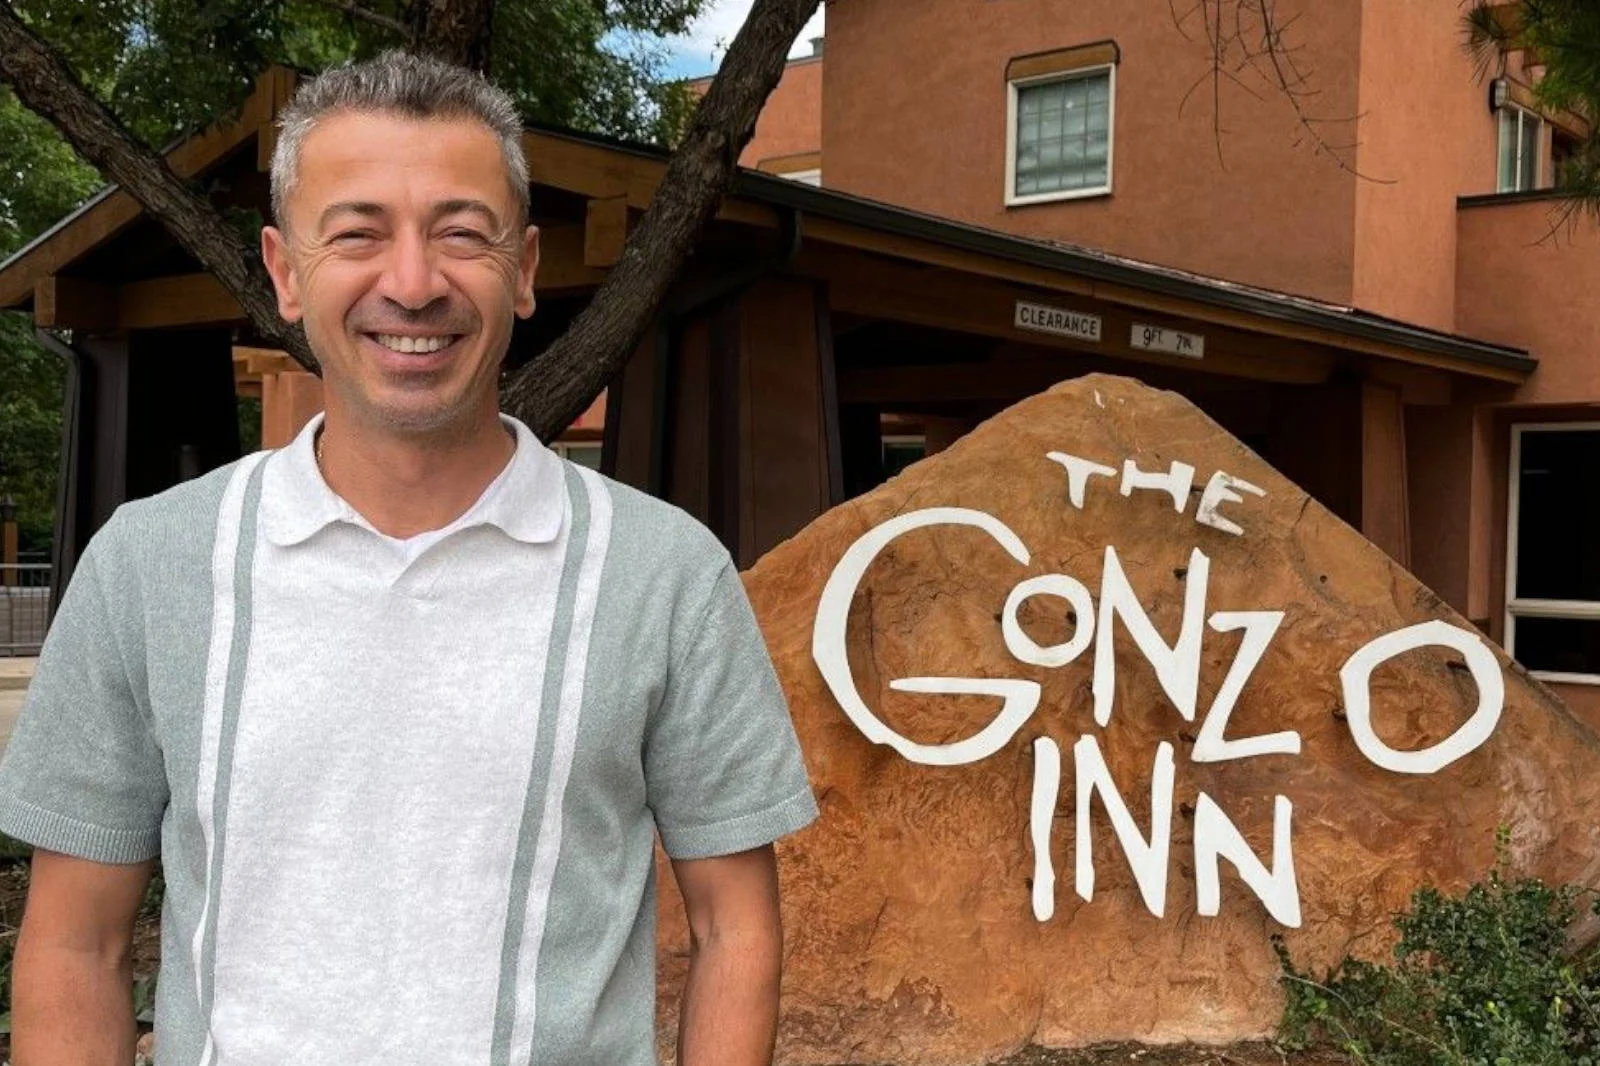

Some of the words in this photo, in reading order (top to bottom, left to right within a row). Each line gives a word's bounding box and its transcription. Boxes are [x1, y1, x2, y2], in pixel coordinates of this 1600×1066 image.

[1020, 307, 1097, 336] CLEARANCE
[1046, 451, 1266, 535] THE
[1031, 734, 1302, 928] INN
